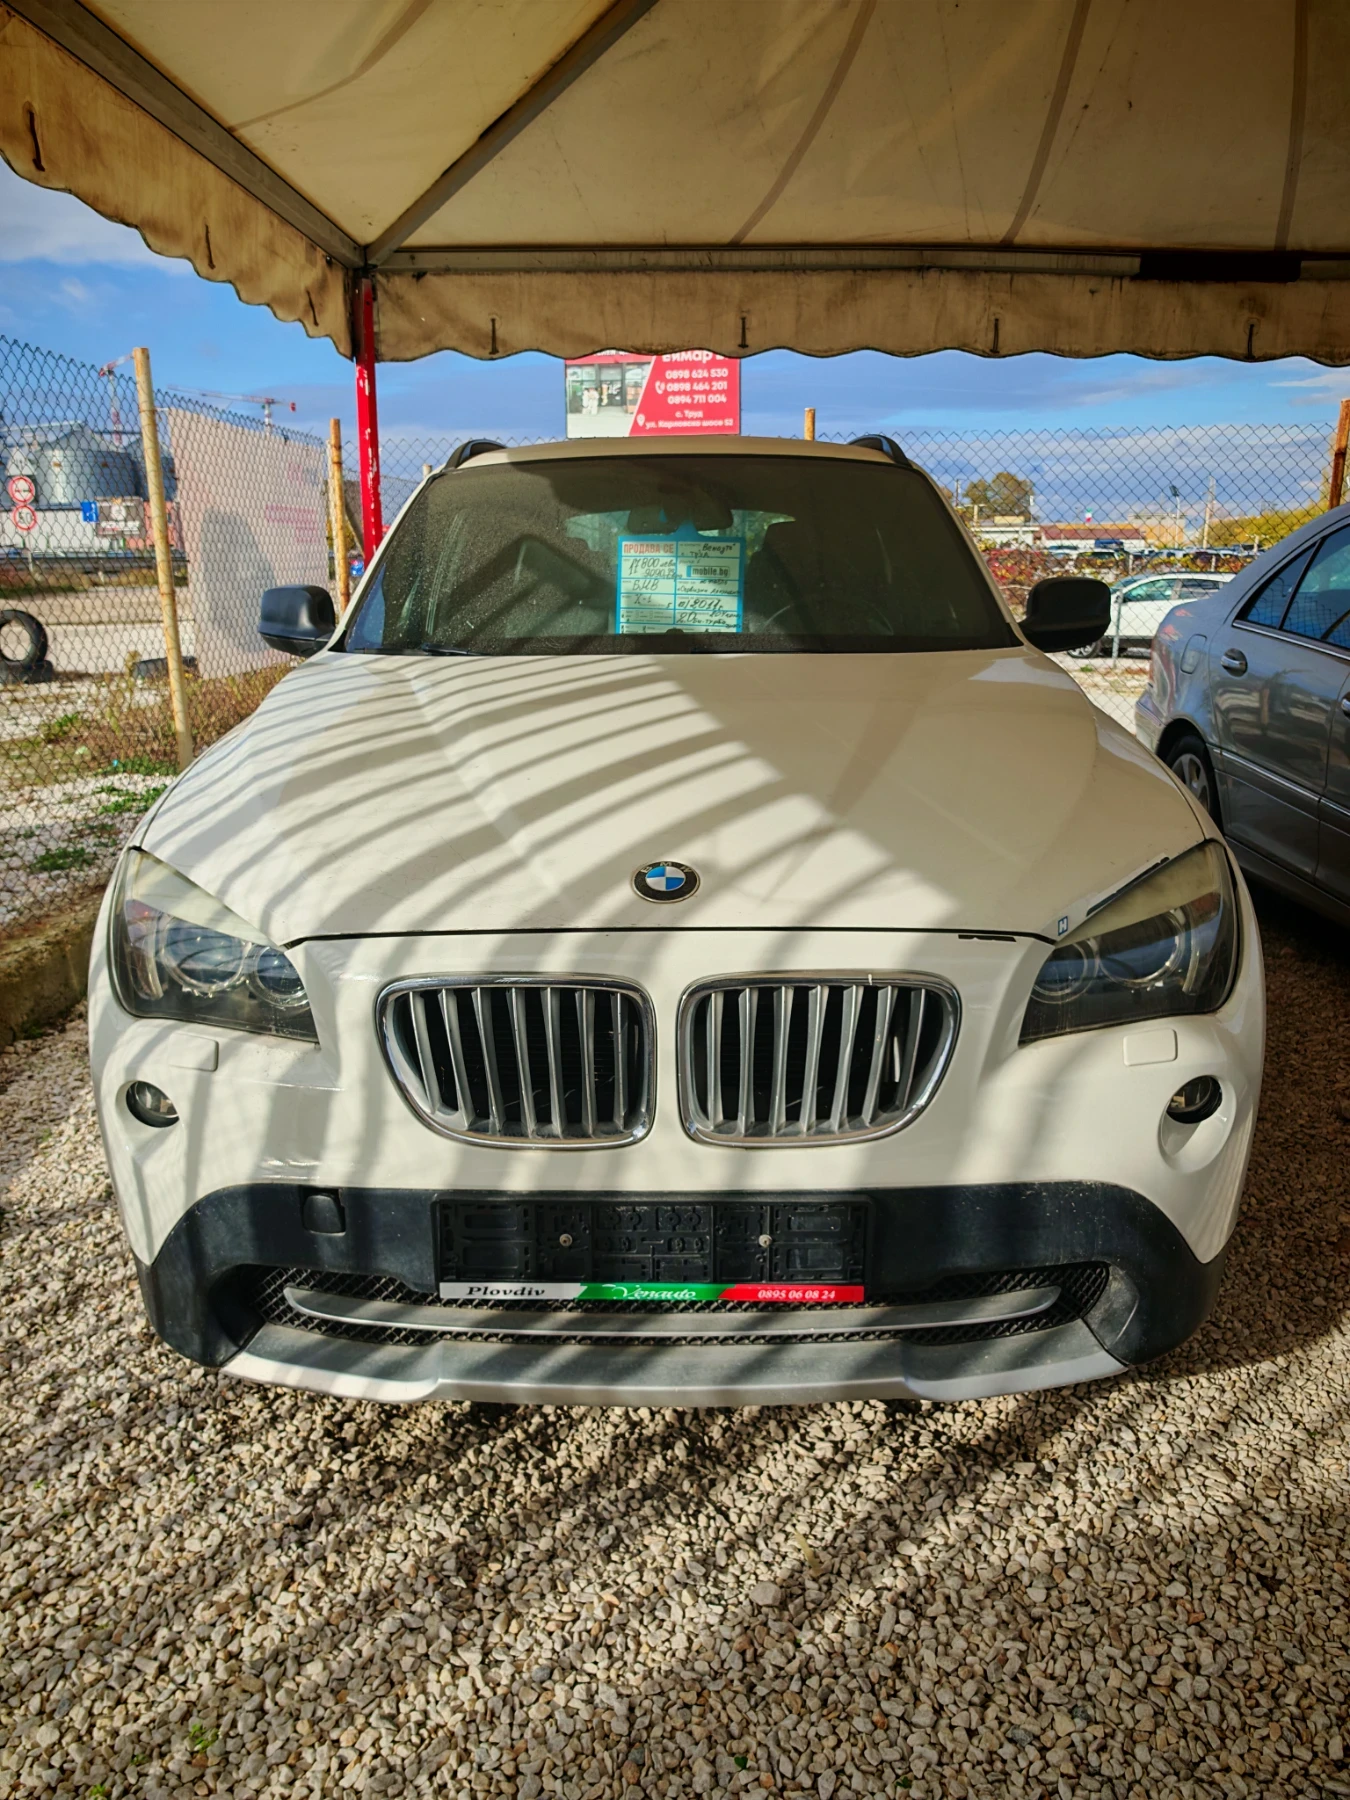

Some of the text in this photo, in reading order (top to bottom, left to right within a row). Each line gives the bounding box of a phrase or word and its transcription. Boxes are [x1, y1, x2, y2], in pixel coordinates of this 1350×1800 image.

[665, 368, 729, 379] 0898 624 530
[666, 381, 728, 392] 0898 464 201
[667, 394, 727, 405] 0894 711 004
[624, 543, 661, 554] ПРОДАВА
[663, 543, 674, 554] СЕ
[692, 566, 729, 577] mobile.bg
[640, 861, 693, 873] BMW
[466, 1285, 546, 1297] Plovdiv
[602, 1283, 697, 1301] Venauto
[757, 1289, 836, 1300] 0895 06 08 24
